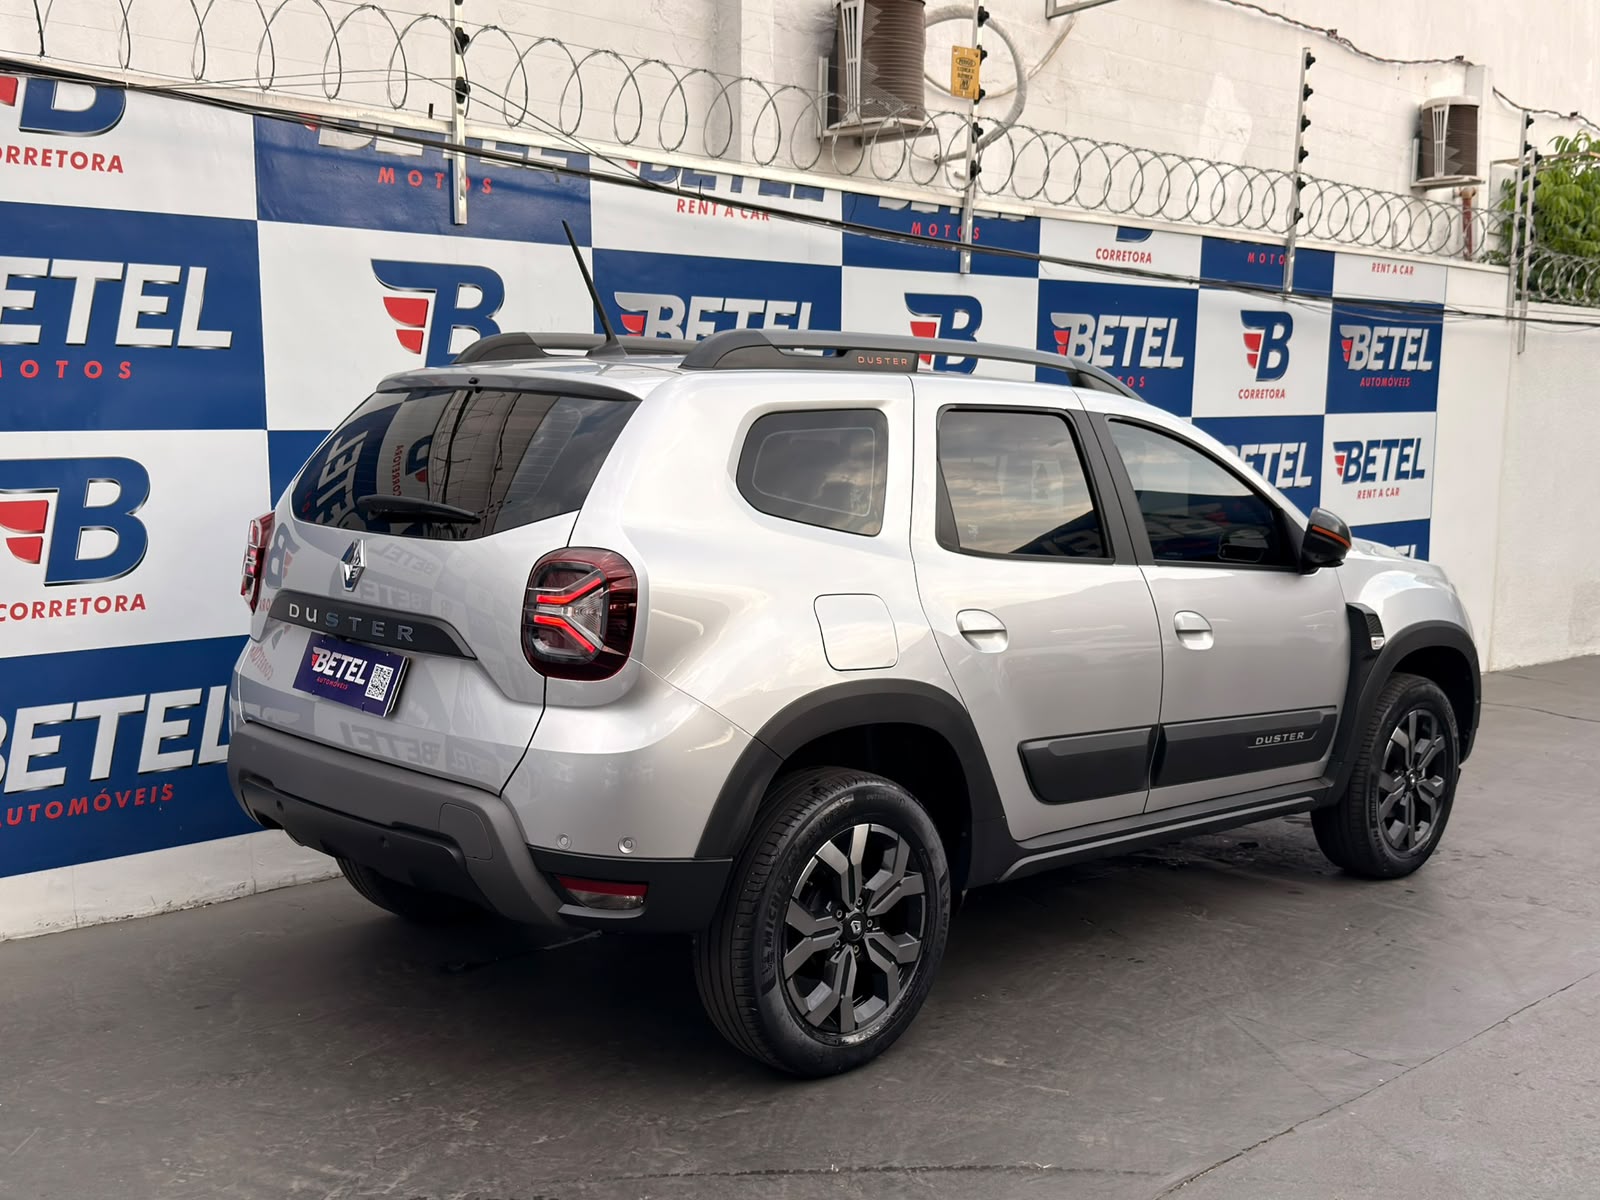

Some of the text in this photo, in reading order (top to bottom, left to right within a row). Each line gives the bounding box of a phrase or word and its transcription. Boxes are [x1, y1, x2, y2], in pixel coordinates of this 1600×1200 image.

[0, 145, 124, 173] RRETORA
[378, 167, 492, 194] MOTS
[677, 198, 719, 216] RENT
[724, 206, 734, 217] A
[1096, 248, 1152, 264] CORRETORA
[1248, 252, 1286, 265] MOTO
[1372, 262, 1414, 275] RENT A CAR
[614, 292, 824, 357] BETEL
[1050, 312, 1184, 369] BETEL
[1340, 325, 1432, 371] BETEL
[0, 360, 132, 379] OTOS
[857, 356, 907, 366] DUSTER
[1238, 388, 1286, 400] CORRETORA
[1360, 375, 1411, 387] AUTOMÓVEIS
[1224, 442, 1312, 488] ETEL
[1333, 438, 1425, 484] BETEL
[1357, 487, 1400, 499] RENT A CAR
[288, 603, 414, 642] DUSTER
[312, 646, 368, 685] BETEL
[0, 685, 229, 794] ETEL
[1255, 731, 1304, 745] DUSTER
[0, 784, 174, 829] UTOMÓVEIS
